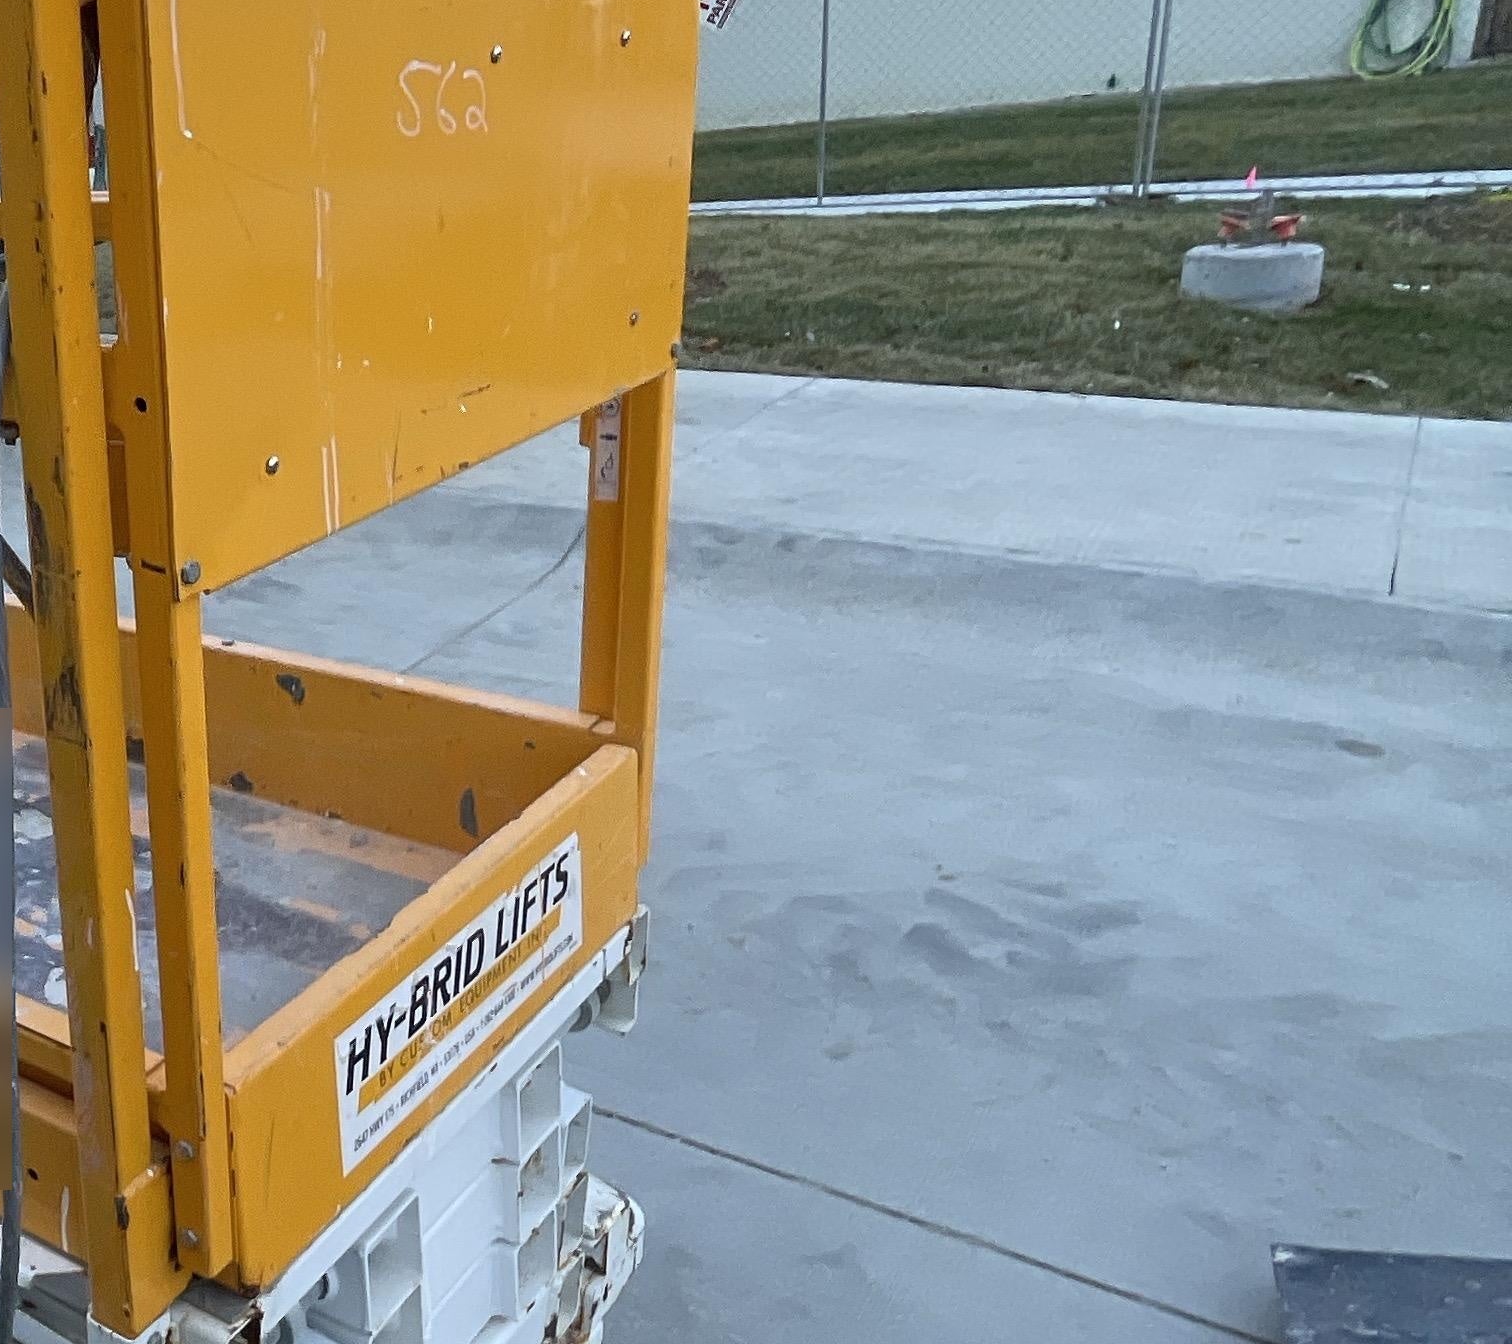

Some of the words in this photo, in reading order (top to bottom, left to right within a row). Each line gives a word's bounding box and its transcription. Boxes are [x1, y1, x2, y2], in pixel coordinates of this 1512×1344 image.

[396, 60, 489, 137] 562
[345, 927, 486, 1096] HY-BRID
[494, 852, 570, 960] LIFTS
[379, 1059, 396, 1088] BY
